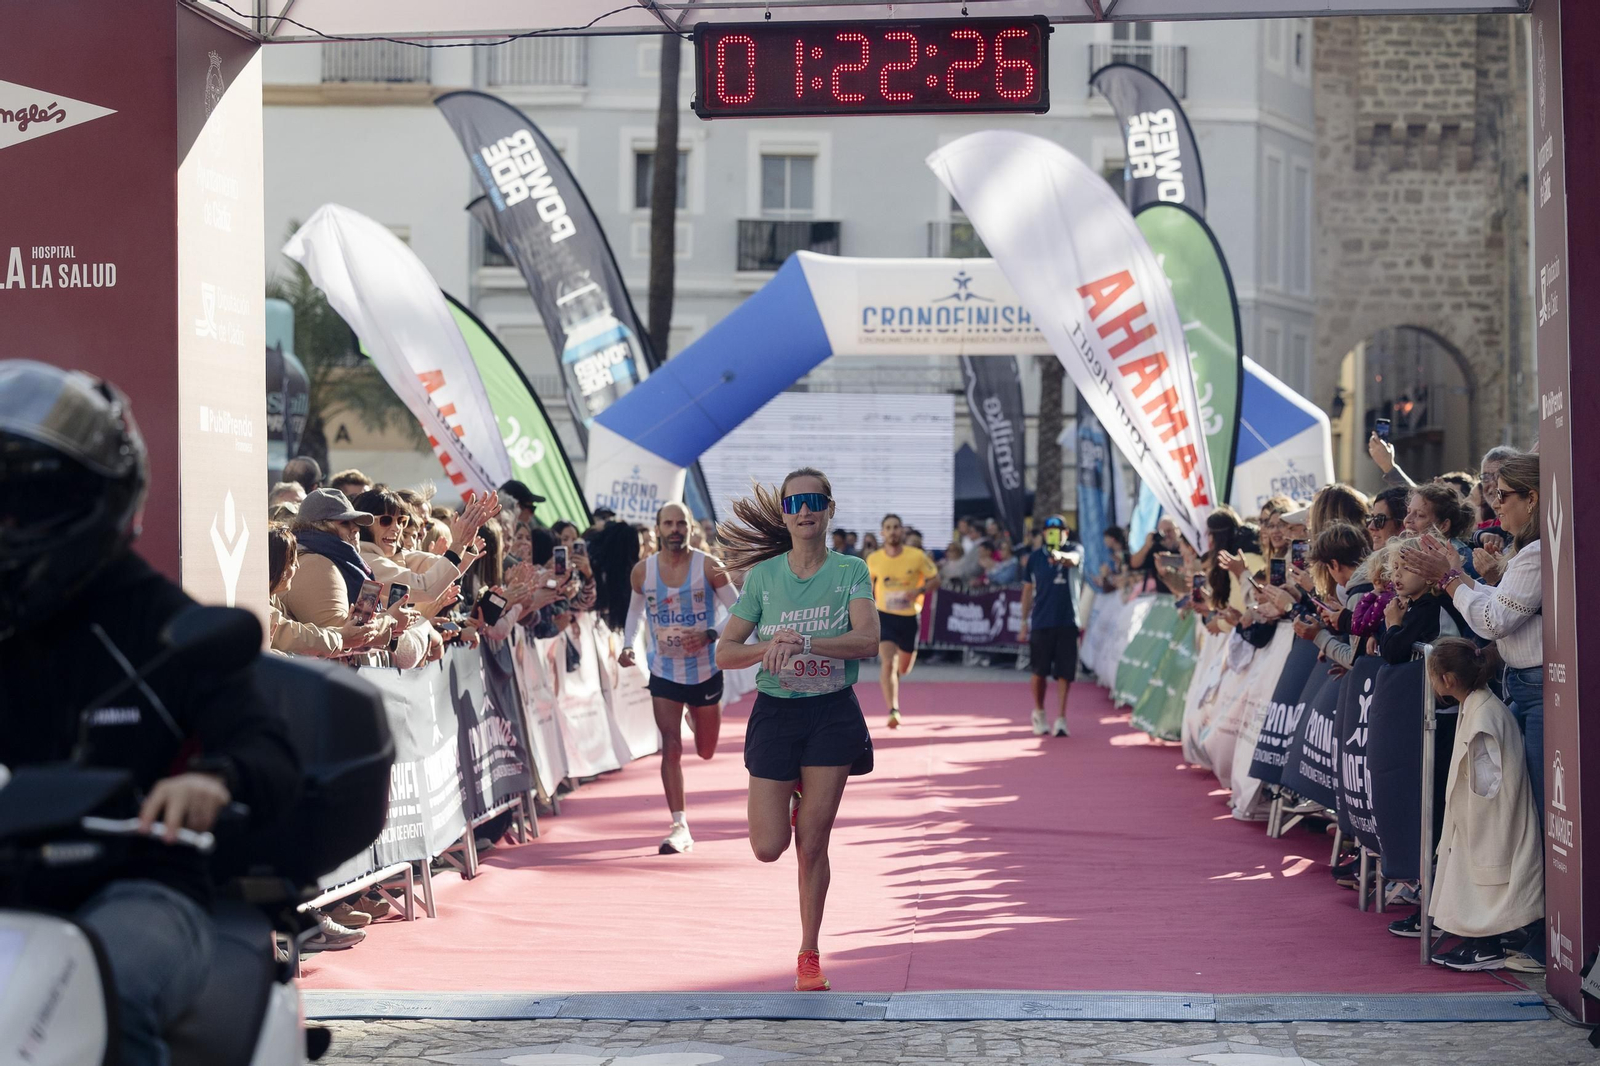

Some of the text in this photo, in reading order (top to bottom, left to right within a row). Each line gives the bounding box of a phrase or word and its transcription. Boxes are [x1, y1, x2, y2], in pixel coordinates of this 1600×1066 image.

[0, 101, 66, 132] nglés
[0, 246, 76, 289] A HOSPITAL
[31, 263, 117, 288] LA SALUD
[862, 306, 1041, 335] CRONOFINISH
[650, 610, 707, 626] málaga
[780, 605, 830, 622] MEDIA
[793, 659, 831, 677] 935
